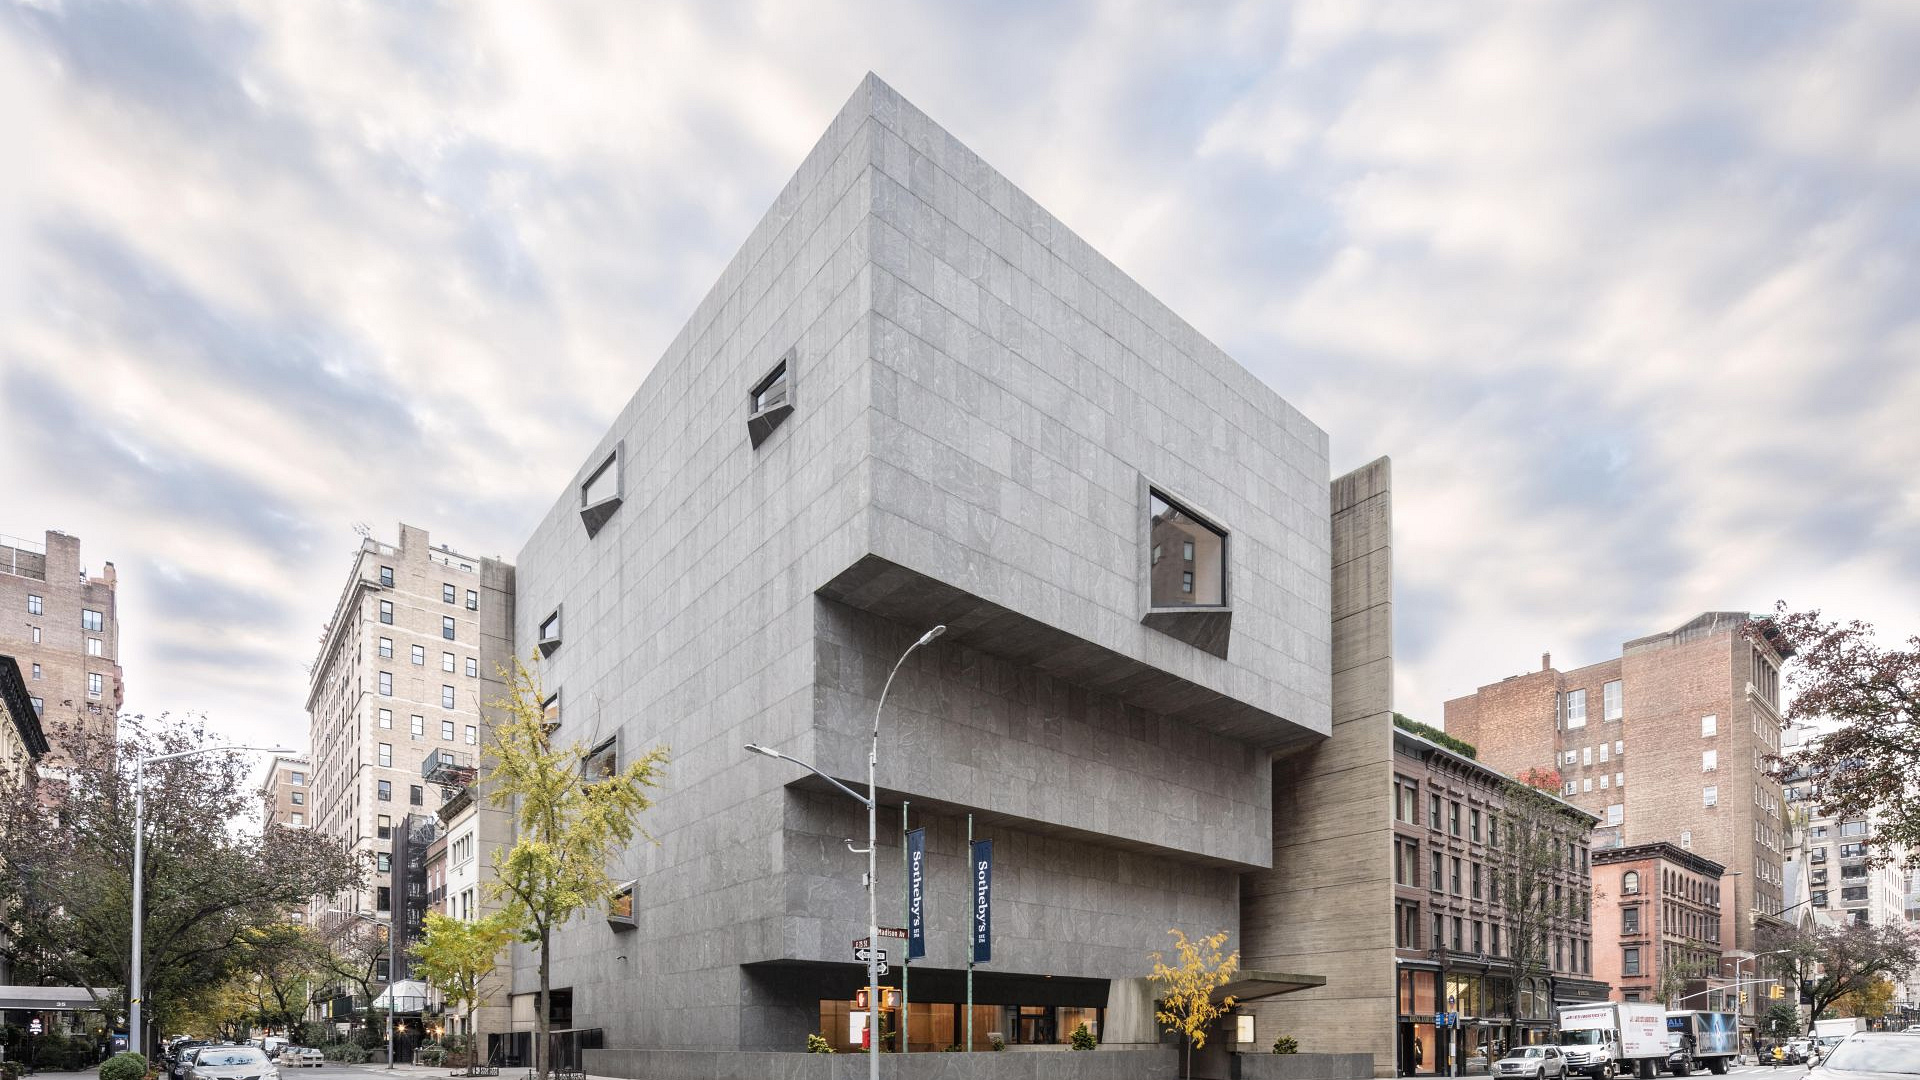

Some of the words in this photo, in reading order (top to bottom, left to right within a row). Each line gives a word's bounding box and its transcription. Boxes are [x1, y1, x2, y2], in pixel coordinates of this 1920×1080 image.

[911, 851, 922, 927] Sotheby's
[976, 861, 988, 932] Sotheby's
[878, 928, 897, 936] Madison
